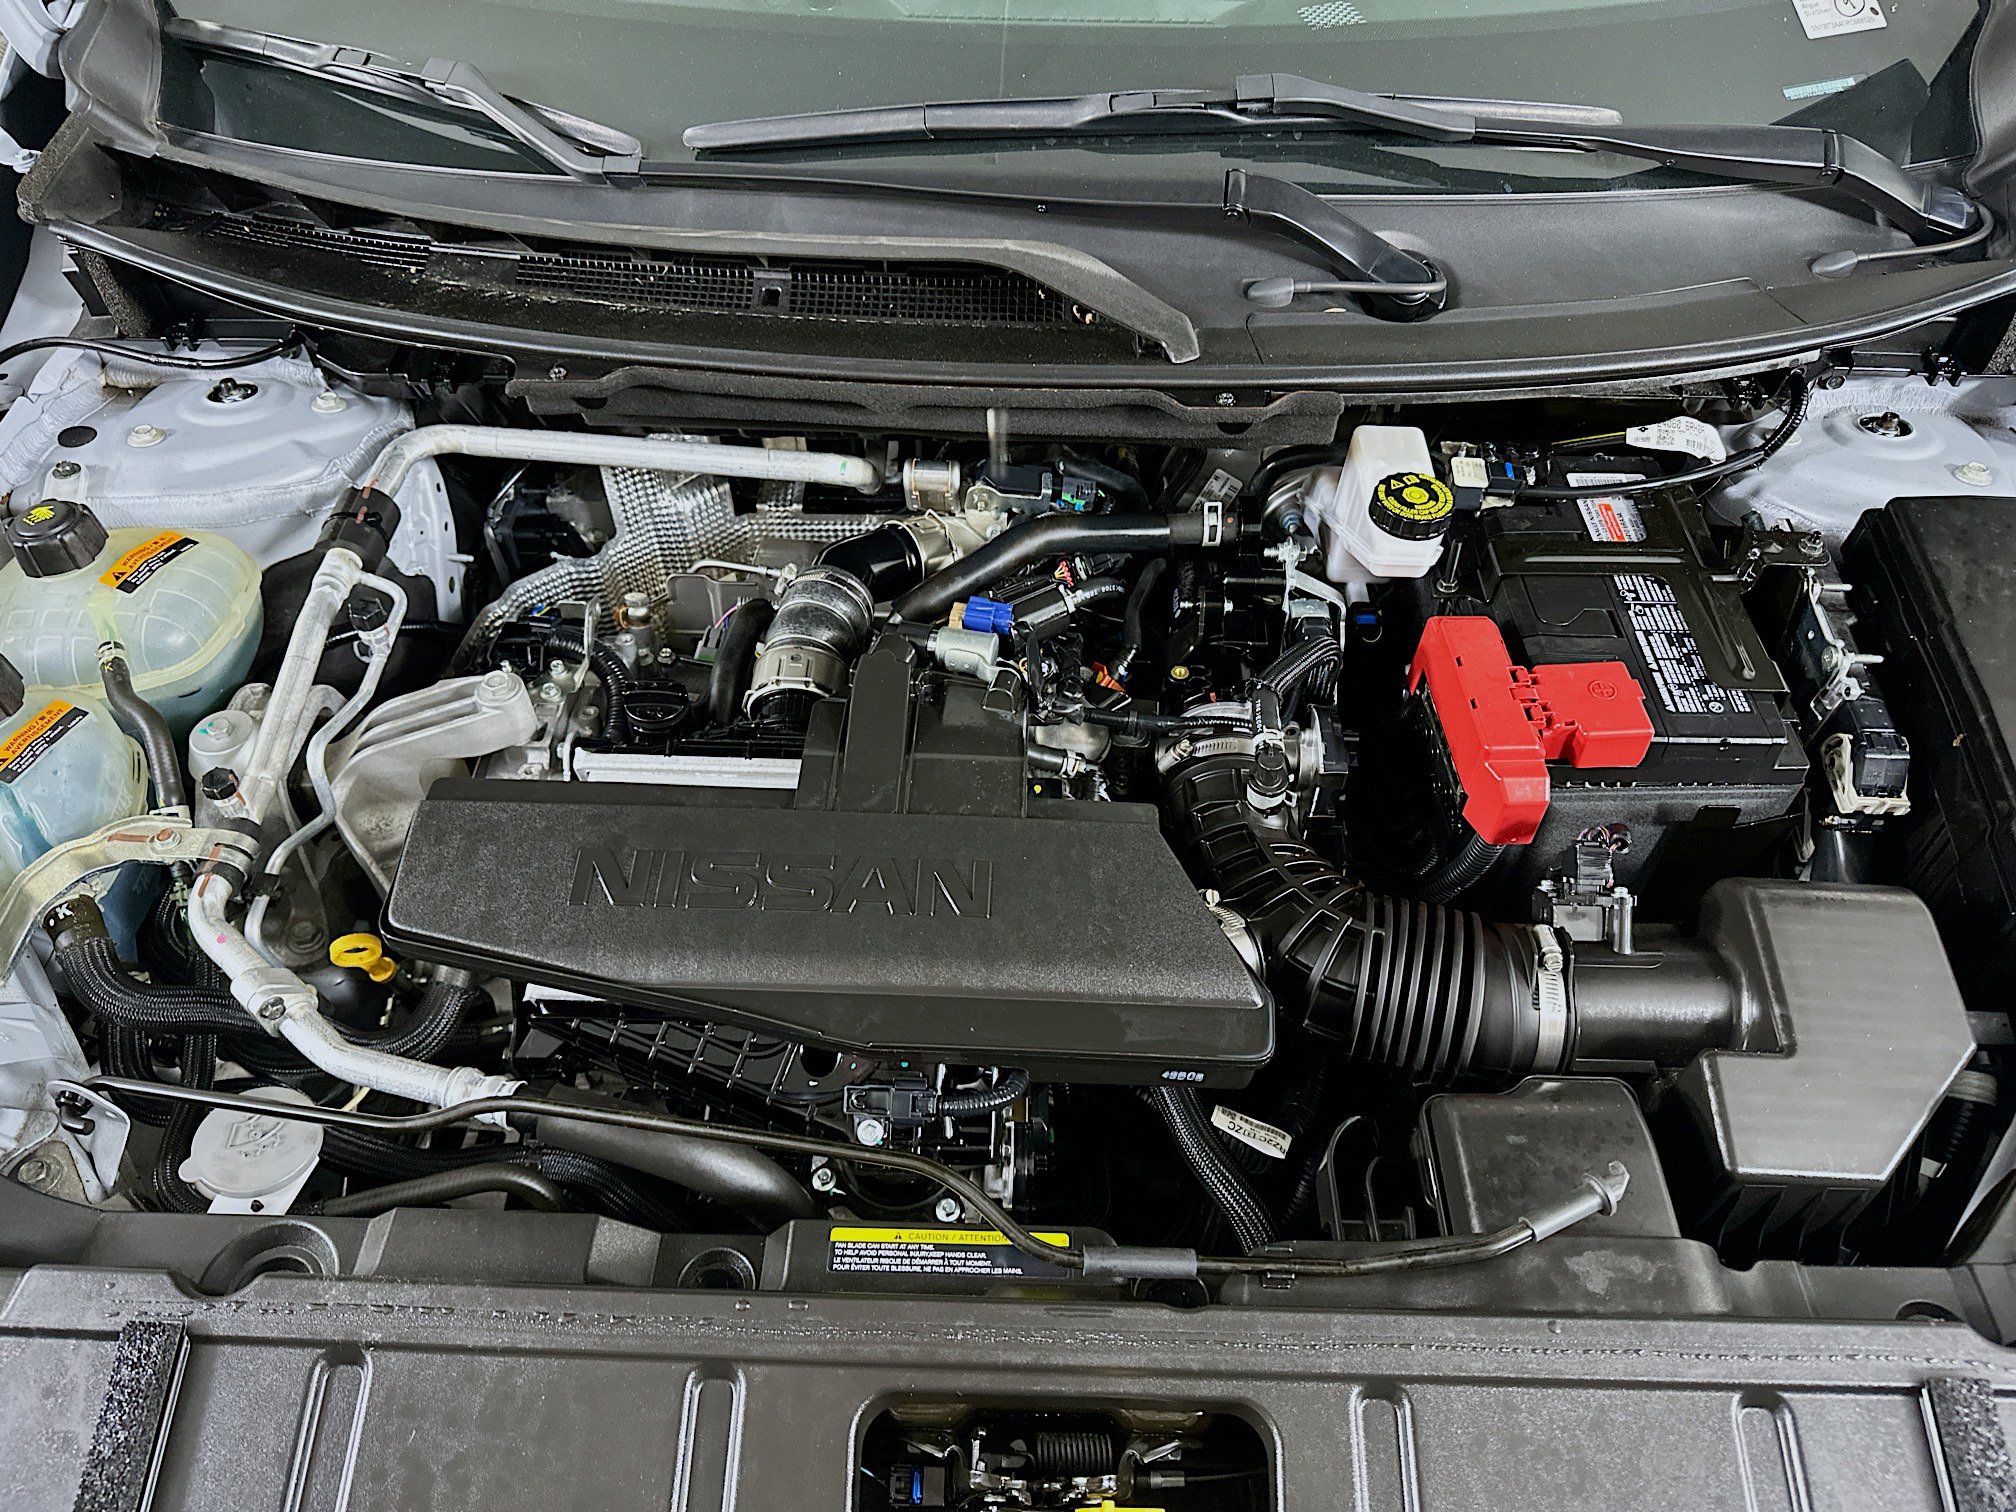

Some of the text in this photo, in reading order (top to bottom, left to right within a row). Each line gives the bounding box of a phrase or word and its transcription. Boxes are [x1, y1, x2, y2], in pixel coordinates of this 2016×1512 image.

[103, 662, 114, 672] K
[4, 725, 36, 752] WARNING
[567, 847, 994, 919] NISSAN
[55, 901, 75, 920] K
[908, 1232, 949, 1241] CAUTION
